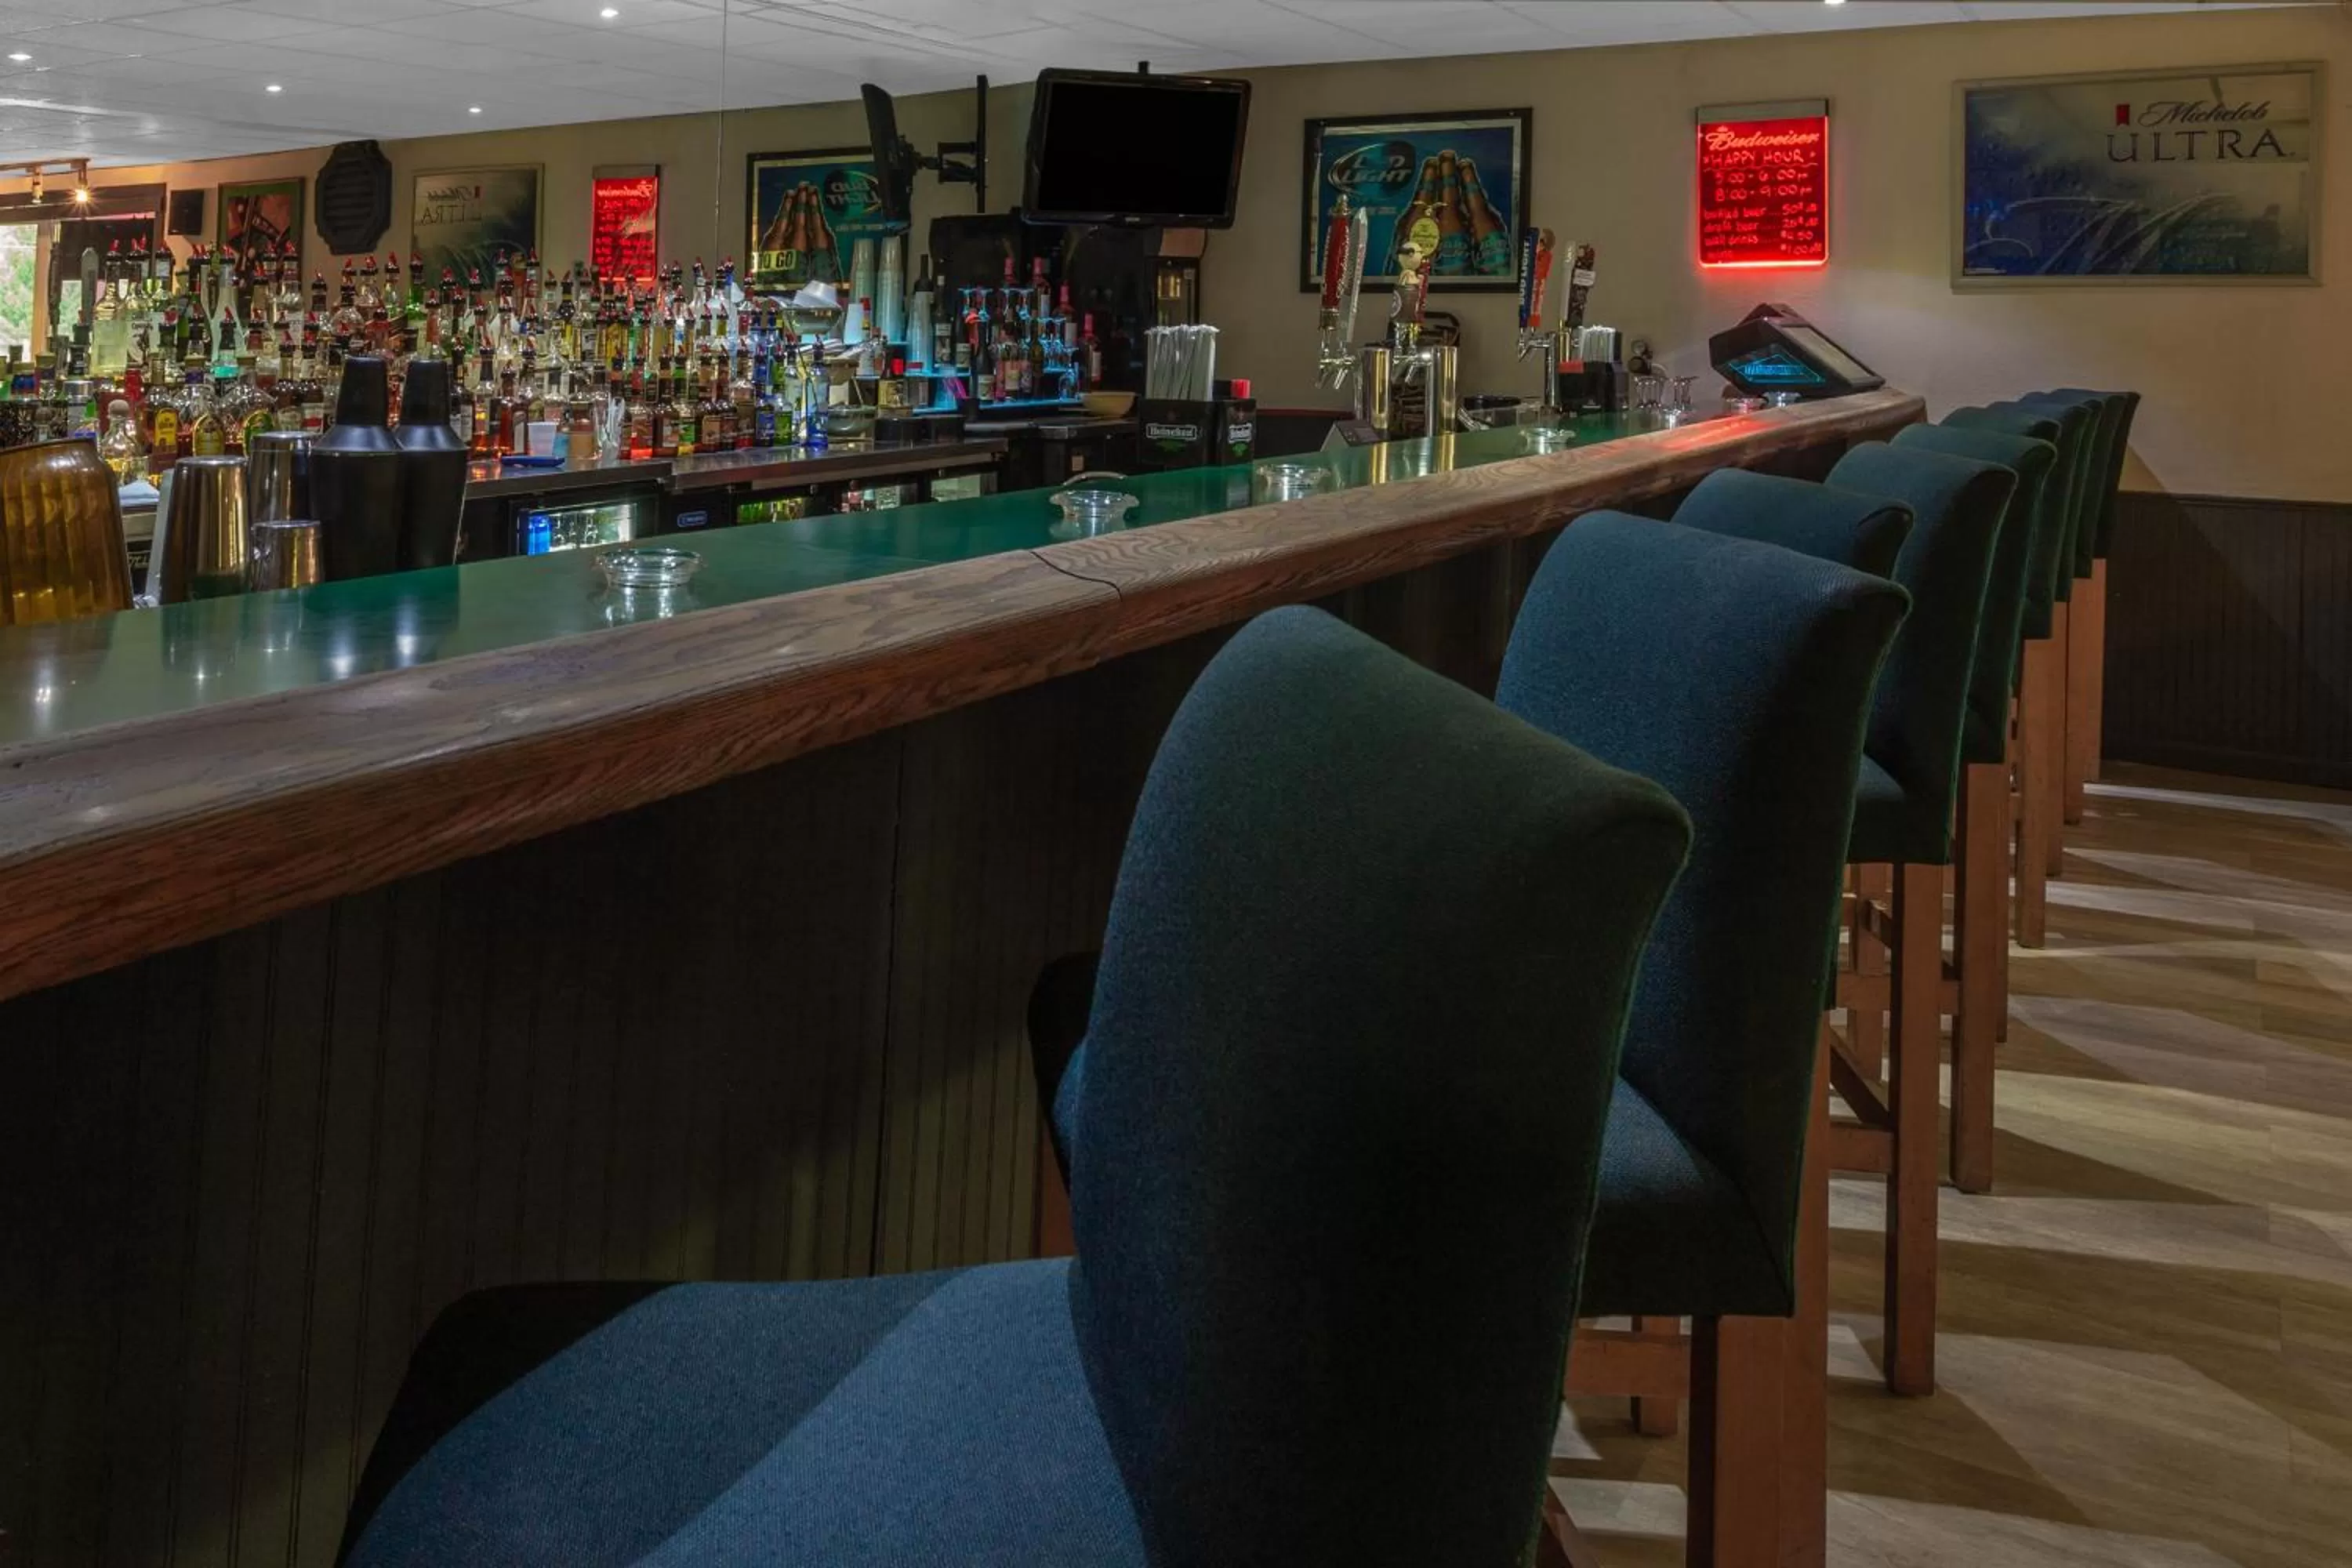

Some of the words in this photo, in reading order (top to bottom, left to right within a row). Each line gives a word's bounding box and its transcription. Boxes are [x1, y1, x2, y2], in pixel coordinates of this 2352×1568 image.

[2137, 100, 2270, 127] Michelob
[1705, 130, 1820, 151] Budweiser
[2107, 128, 2287, 162] ULTRA
[1711, 150, 1756, 168] HAPPY
[1764, 148, 1805, 164] HOUR
[1341, 169, 1412, 182] LIGHT
[775, 250, 793, 267] GO
